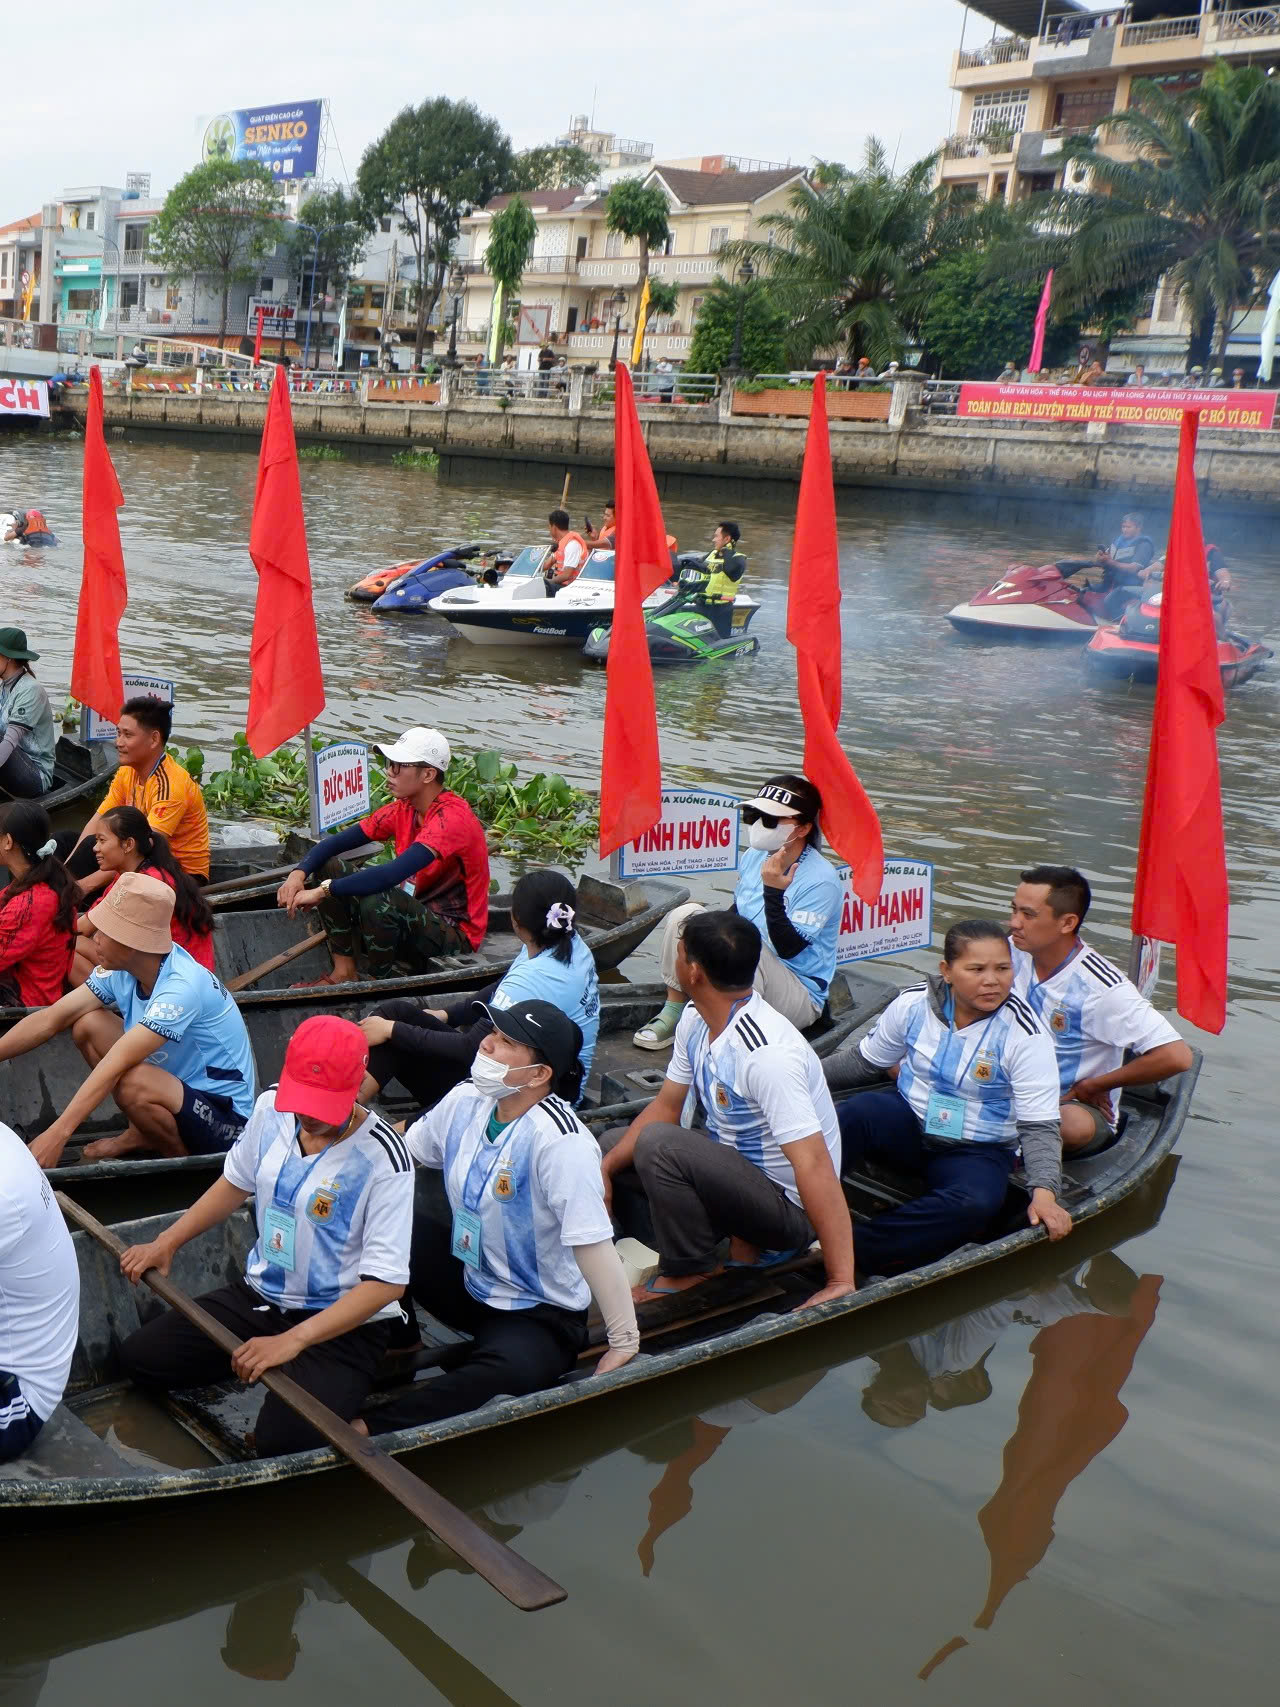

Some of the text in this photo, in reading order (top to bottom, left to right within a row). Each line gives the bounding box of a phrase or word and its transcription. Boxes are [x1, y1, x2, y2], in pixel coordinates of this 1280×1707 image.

[245, 120, 308, 144] SENKO
[1061, 388, 1078, 396] THAO
[1126, 390, 1144, 398] LONG
[968, 399, 990, 413] TOÀN
[992, 399, 1012, 414] DÂN
[1014, 400, 1032, 415] RÈN
[1034, 400, 1065, 418] LUYỆN
[1066, 402, 1092, 417] THÂN
[1094, 399, 1114, 418] THỂ
[1116, 406, 1142, 420] THEO
[1241, 412, 1262, 426] ĐẠI
[533, 626, 567, 636] FastBoat
[360, 747, 366, 756] LÁ
[324, 758, 364, 806] ĐỨC HUỆ
[673, 794, 706, 805] XUỒNG
[723, 800, 734, 808] LÁ
[678, 815, 730, 850] HƯNG
[884, 863, 928, 876] ỒNG BA LÁ
[840, 887, 924, 936] ÂN THẠNH
